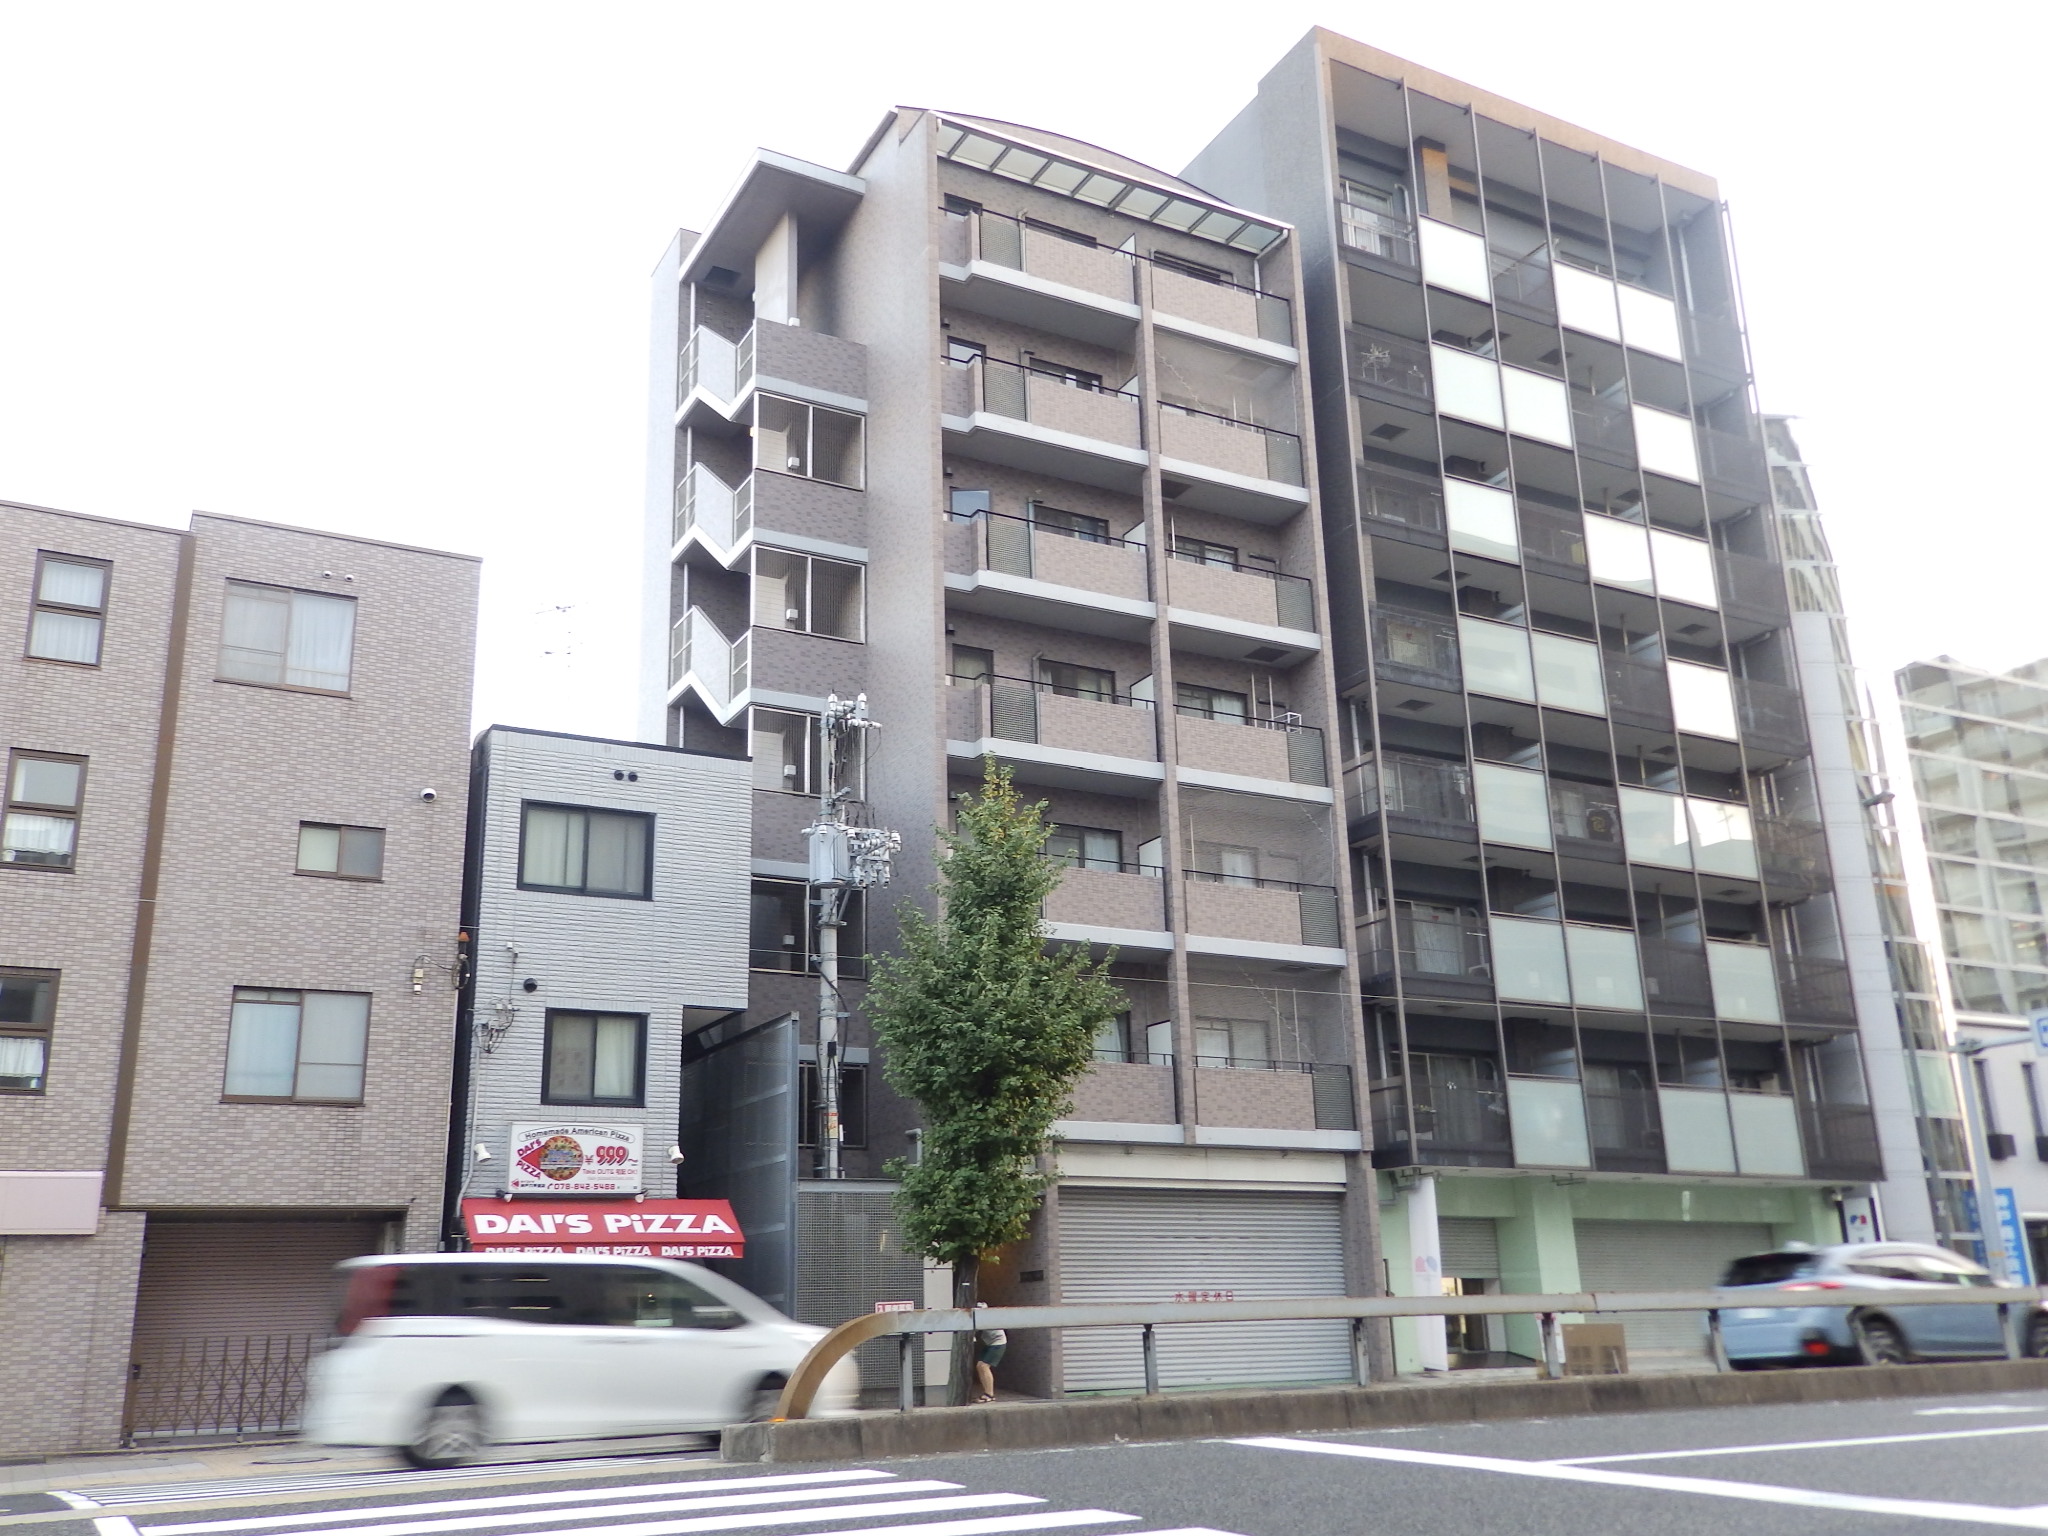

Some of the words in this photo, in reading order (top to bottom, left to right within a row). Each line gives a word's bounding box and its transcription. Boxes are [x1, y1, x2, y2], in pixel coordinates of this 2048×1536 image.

[525, 1128, 569, 1140] Homemade
[572, 1127, 608, 1137] American
[610, 1130, 630, 1142] Pizza
[517, 1138, 543, 1157] DAI'S
[473, 1214, 593, 1235] DAI'S
[576, 1246, 610, 1255] DAI'S
[661, 1246, 695, 1256] DAI'S
